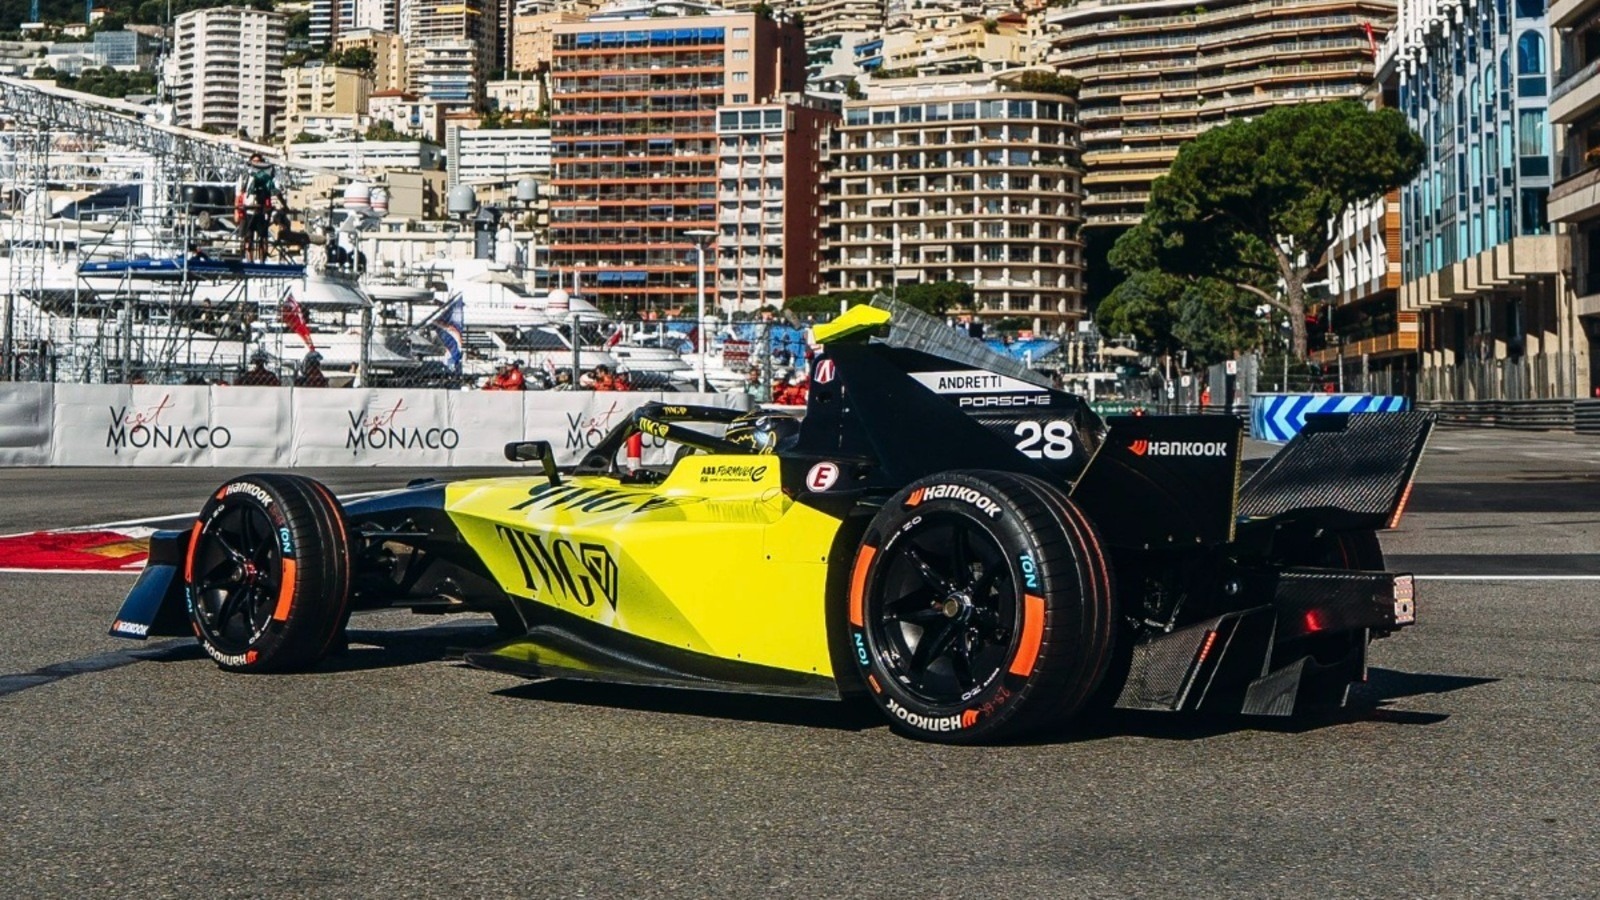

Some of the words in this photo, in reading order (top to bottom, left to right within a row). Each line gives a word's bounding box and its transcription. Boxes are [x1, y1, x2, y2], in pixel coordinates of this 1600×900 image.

[938, 374, 1002, 390] ANDRETTI
[110, 394, 175, 432] Visit
[959, 395, 1051, 408] PORSCHE
[348, 398, 408, 434] Visit
[567, 401, 622, 435] Visit
[106, 425, 231, 449] MONACO
[346, 427, 459, 449] MONACO
[566, 428, 667, 448] MOCO
[1014, 420, 1074, 460] 28
[813, 466, 832, 488] E
